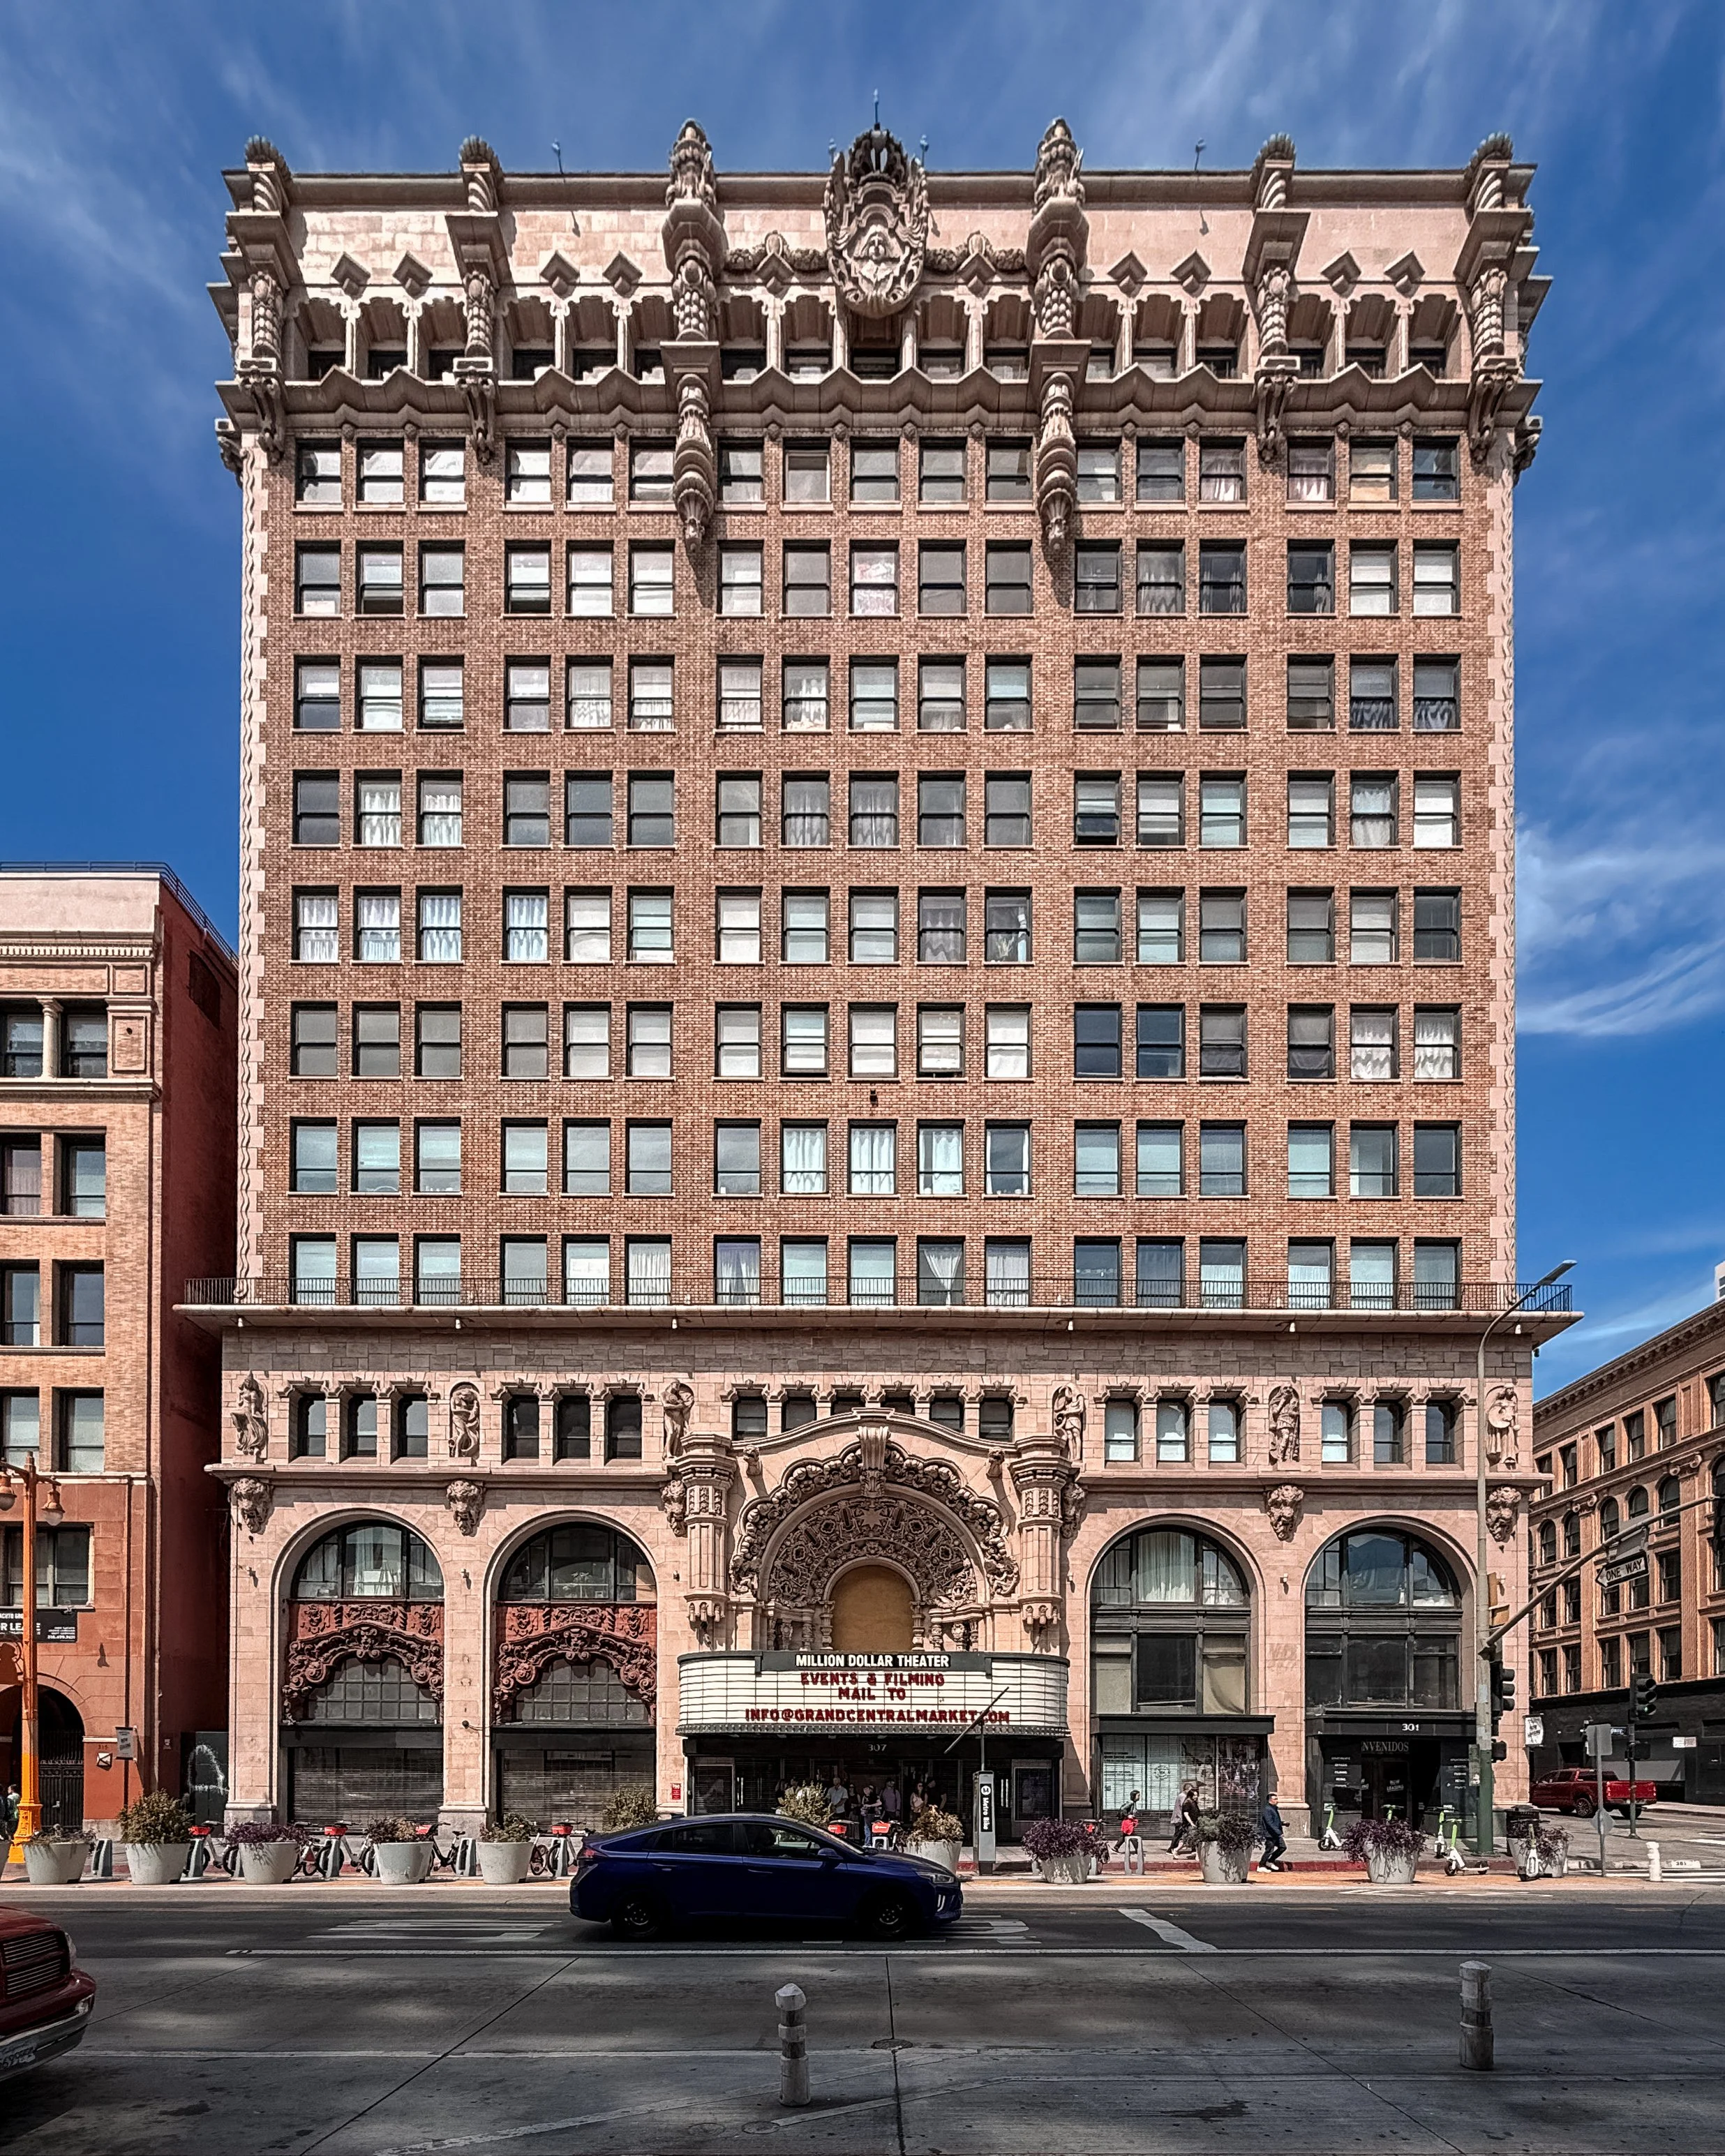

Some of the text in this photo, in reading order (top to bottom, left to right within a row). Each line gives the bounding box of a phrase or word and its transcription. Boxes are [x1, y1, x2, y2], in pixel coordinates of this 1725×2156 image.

[1606, 1559, 1642, 1581] ONE WAY
[796, 1655, 950, 1668] MILLION DOLLAR THEATER
[801, 1672, 945, 1686] EVENTS & FILMING
[838, 1687, 906, 1700] MAIL TO
[745, 1709, 1010, 1723] INFO@GRANDCENTRALMARKETOM
